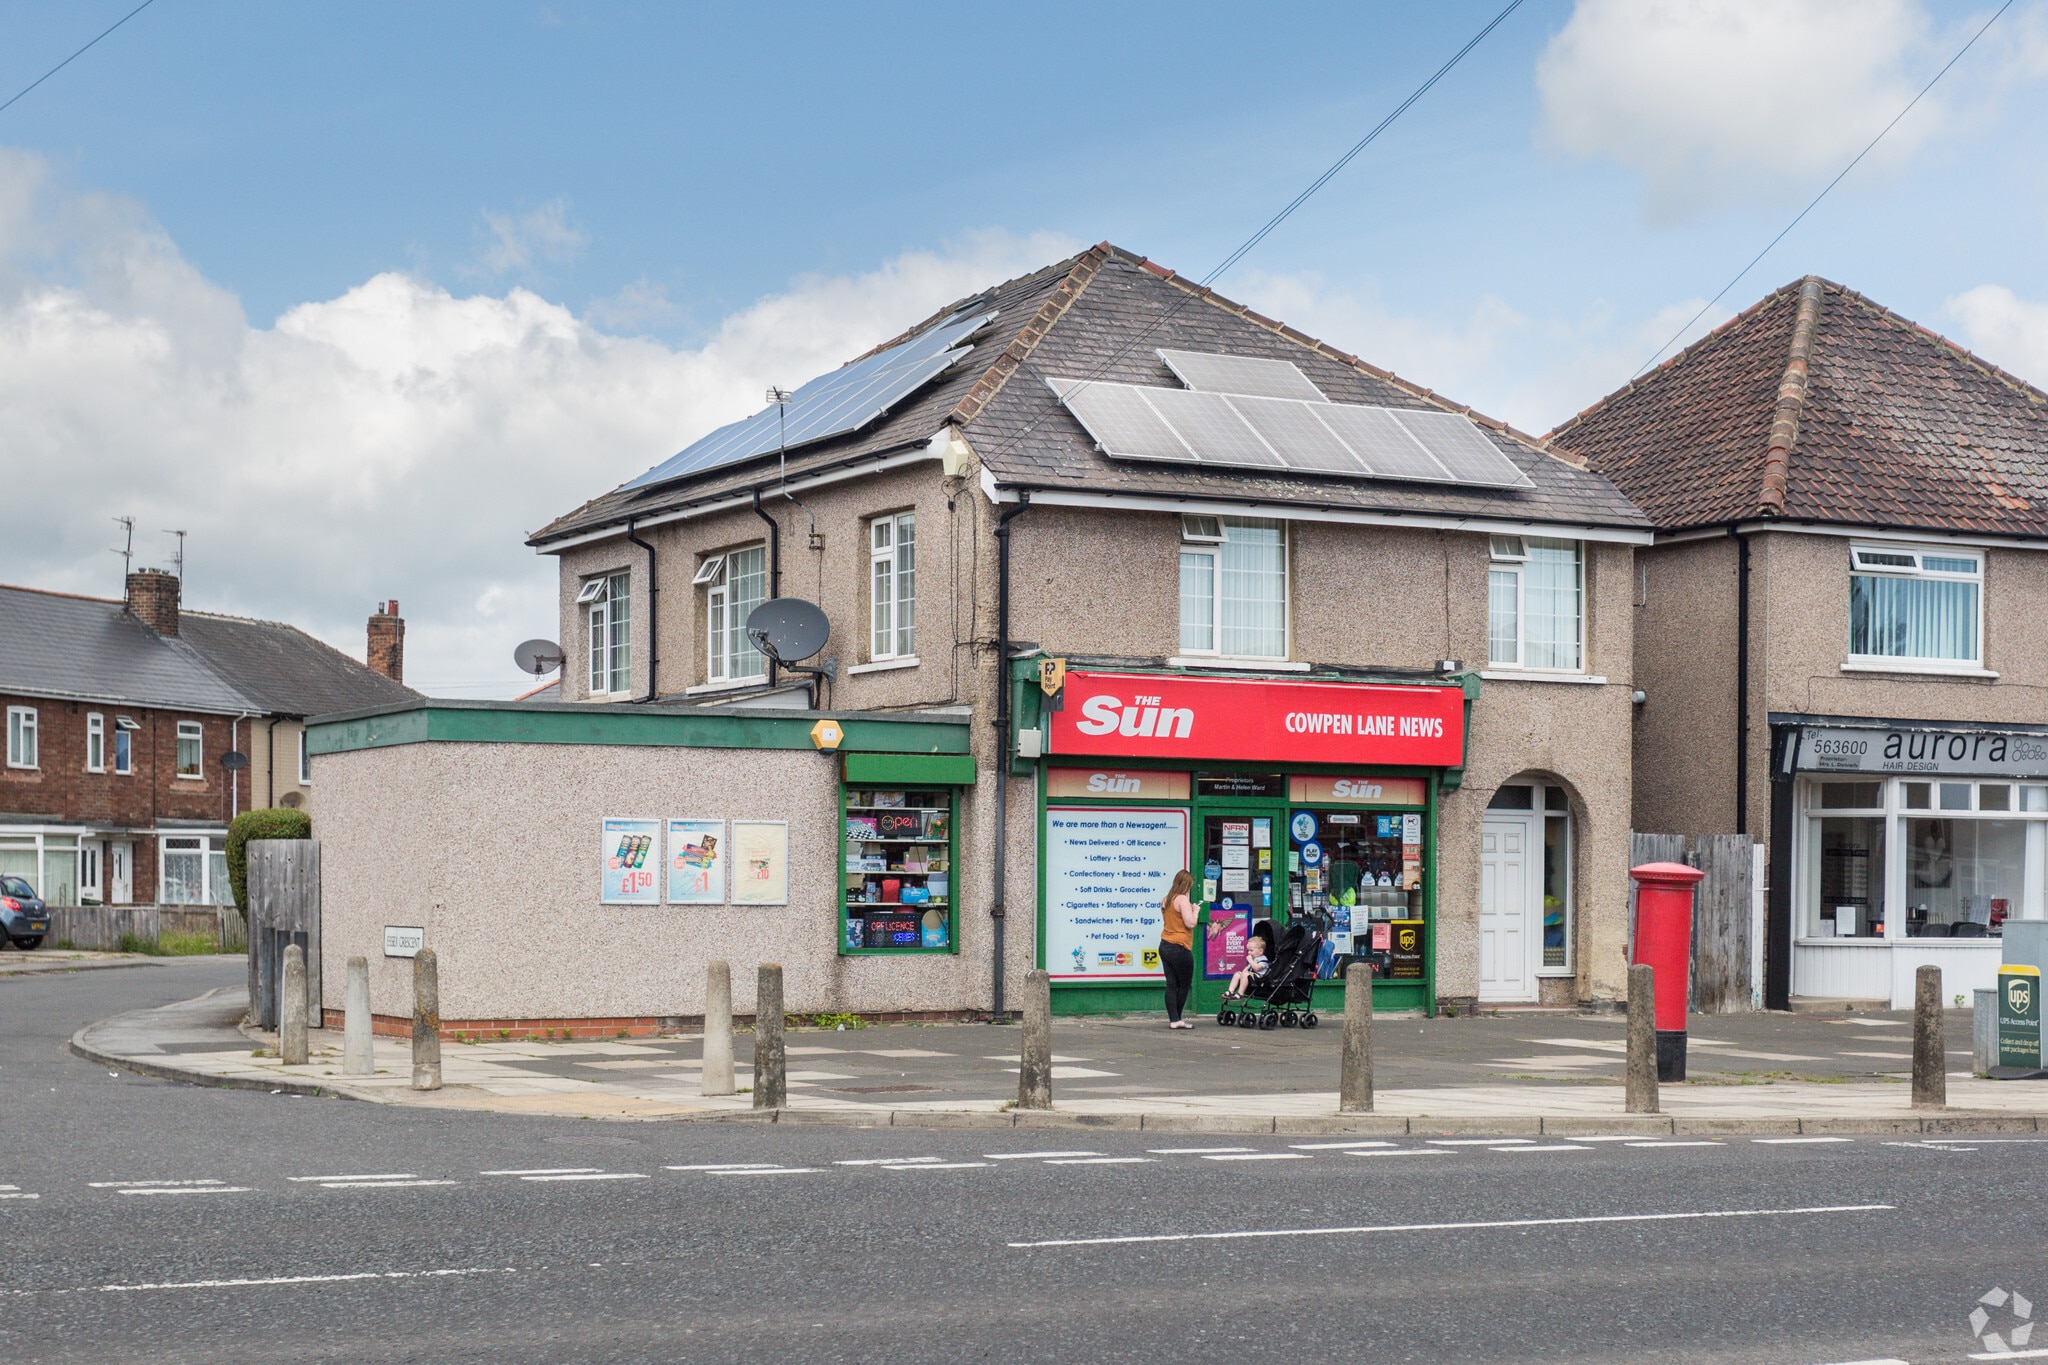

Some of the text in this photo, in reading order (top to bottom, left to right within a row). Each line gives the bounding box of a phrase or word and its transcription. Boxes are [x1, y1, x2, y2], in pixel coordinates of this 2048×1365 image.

[1045, 676, 1053, 684] Pay
[1134, 695, 1162, 706] THE
[1076, 695, 1195, 739] Sun
[1285, 712, 1443, 738] COWPEN LANE NEWS
[1807, 729, 1823, 740] Tel:
[1814, 740, 1868, 755] 563600
[1883, 733, 2008, 762] aurora
[1883, 762, 1940, 771] HAIR DESIGN
[1086, 773, 1141, 793] Sun
[1332, 780, 1383, 799] Sun
[1052, 820, 1064, 828] We
[1080, 821, 1099, 829] more
[1101, 820, 1117, 829] than
[1090, 855, 1111, 863] Lottery
[1069, 871, 1115, 879] Confectionery
[695, 871, 708, 893] £1
[1066, 901, 1099, 909] Cigarettes
[1106, 902, 1138, 910] Stationery
[1140, 917, 1155, 925] Eggs
[1126, 933, 1140, 941] Toys
[1401, 936, 1415, 947] ups
[2010, 989, 2028, 1009] ups
[2000, 1017, 2010, 1025] UPS
[2010, 1018, 2026, 1026] Access
[2000, 1037, 2014, 1045] Collect
